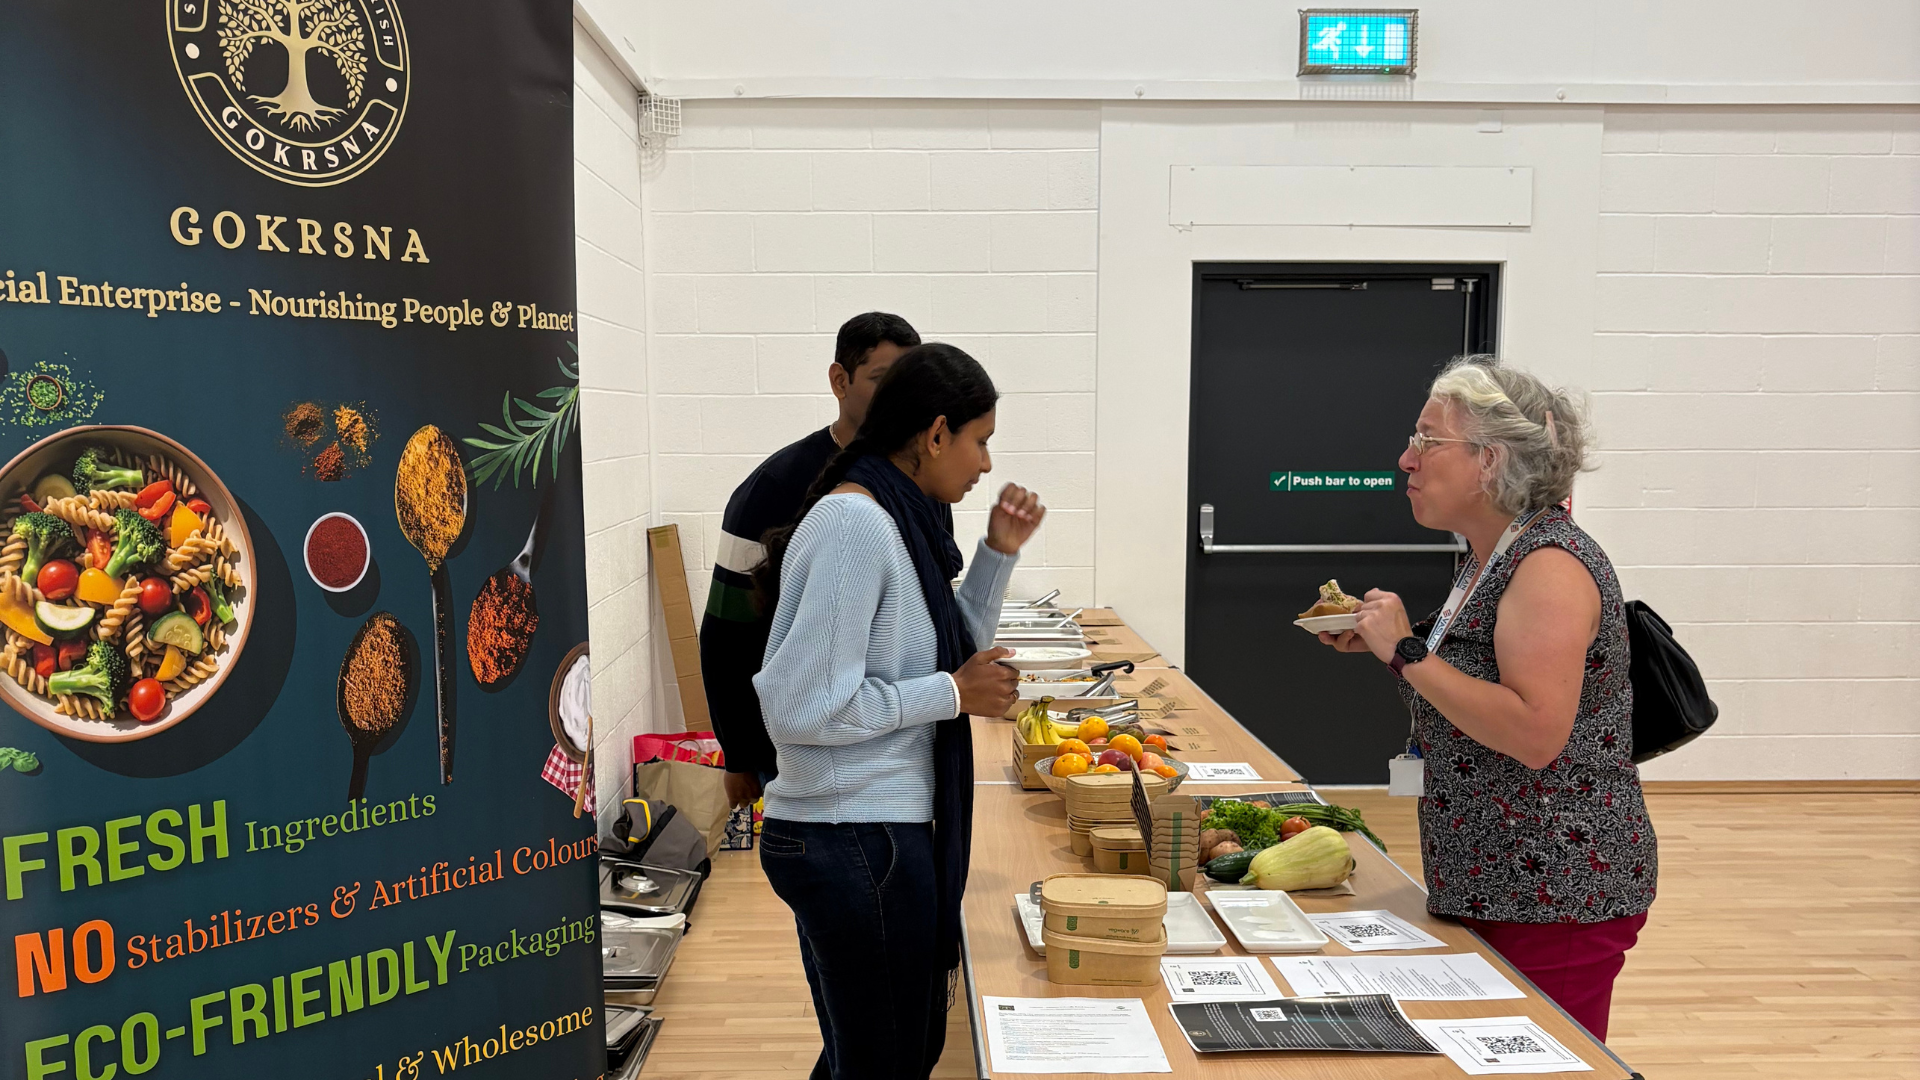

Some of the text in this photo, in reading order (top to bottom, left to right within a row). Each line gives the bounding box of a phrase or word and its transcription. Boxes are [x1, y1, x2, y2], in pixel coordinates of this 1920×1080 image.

[222, 106, 380, 171] GOKRSNA
[169, 206, 430, 264] GOKRSNA
[56, 275, 222, 318] Enterprise
[247, 288, 398, 329] Nourishing
[402, 297, 484, 332] People
[489, 300, 513, 328] &
[516, 304, 575, 333] Planet
[1292, 476, 1393, 488] Push bar to open
[2, 793, 437, 901] FRESH Ingredients
[14, 832, 599, 998] NO Stabilizers & Artificial Colours
[24, 914, 595, 1080] ECO-FRIENDLY Packaging
[430, 1006, 593, 1075] Wholesome
